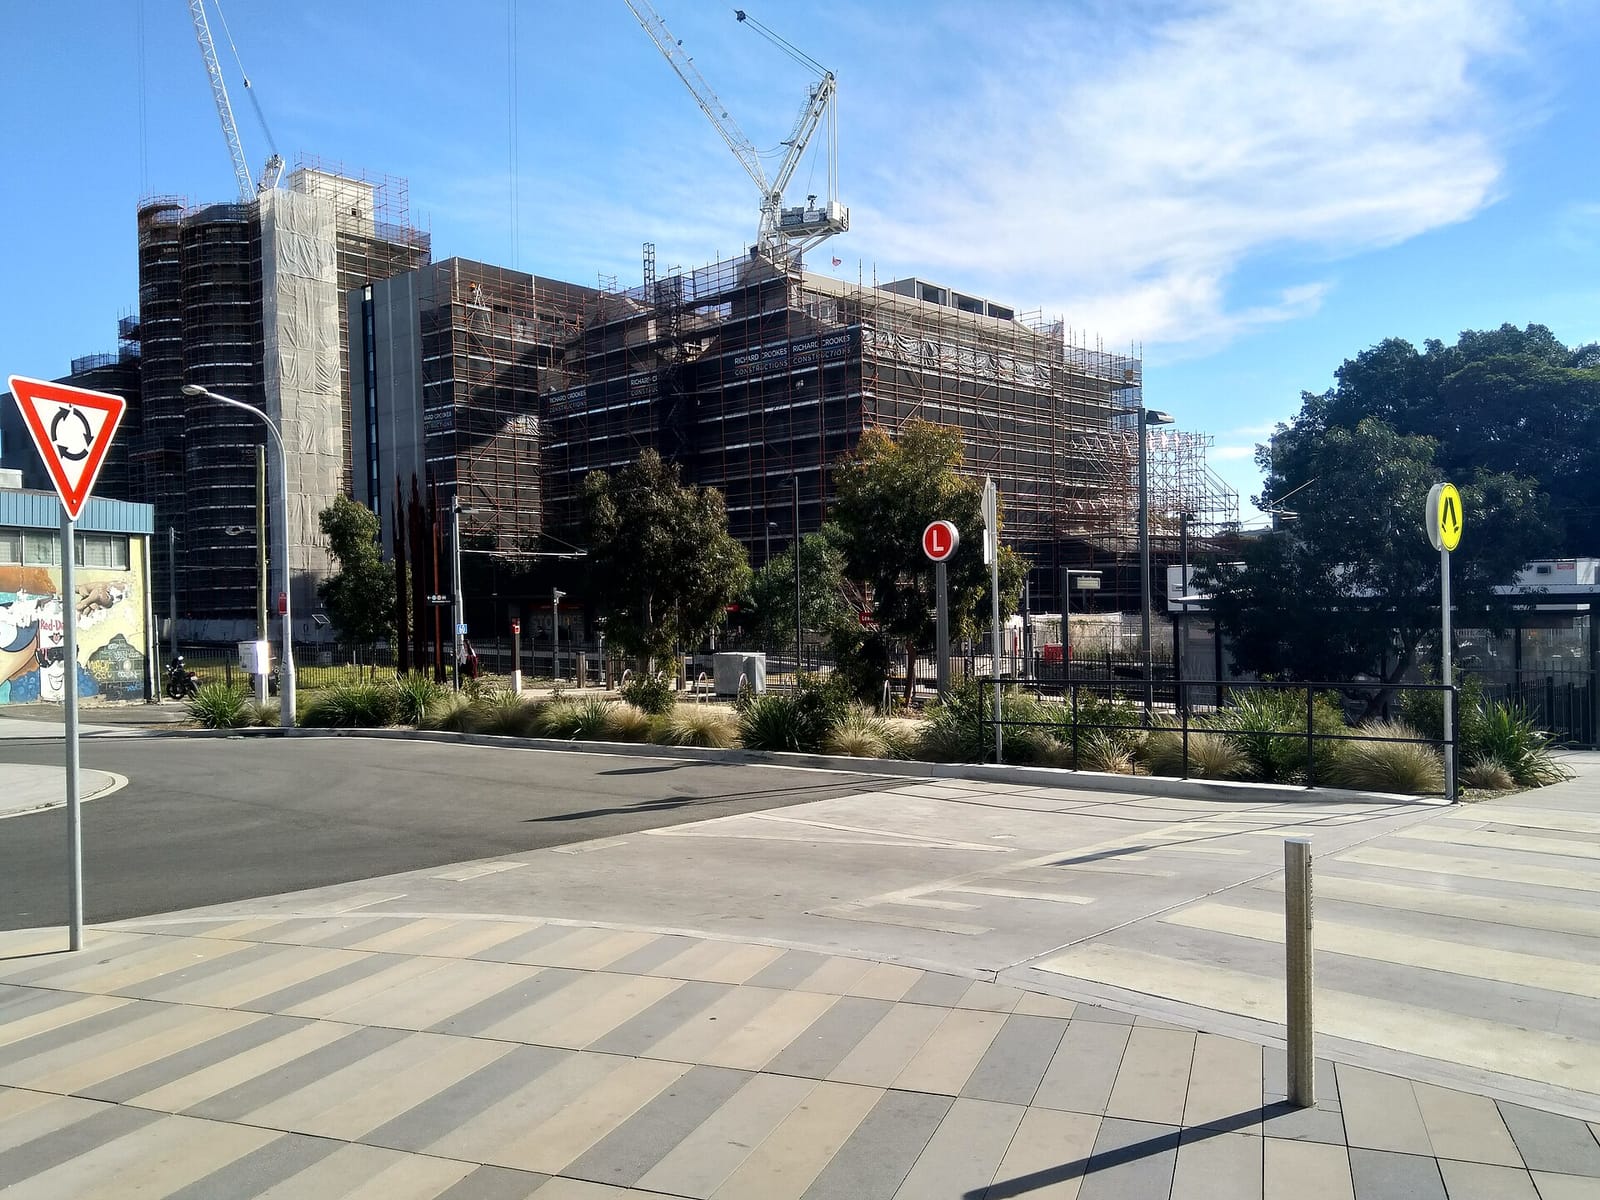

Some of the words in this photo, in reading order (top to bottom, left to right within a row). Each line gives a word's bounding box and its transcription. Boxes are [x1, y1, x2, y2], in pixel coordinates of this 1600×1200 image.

[792, 340, 819, 353] RICHARD
[822, 335, 851, 346] CROOKES
[734, 353, 759, 365] RICHARD
[761, 347, 788, 359] CROOKES
[792, 349, 851, 364] CONSTRUCTIONS
[734, 360, 788, 376] CONSTRUCTIONS
[932, 529, 944, 552] L
